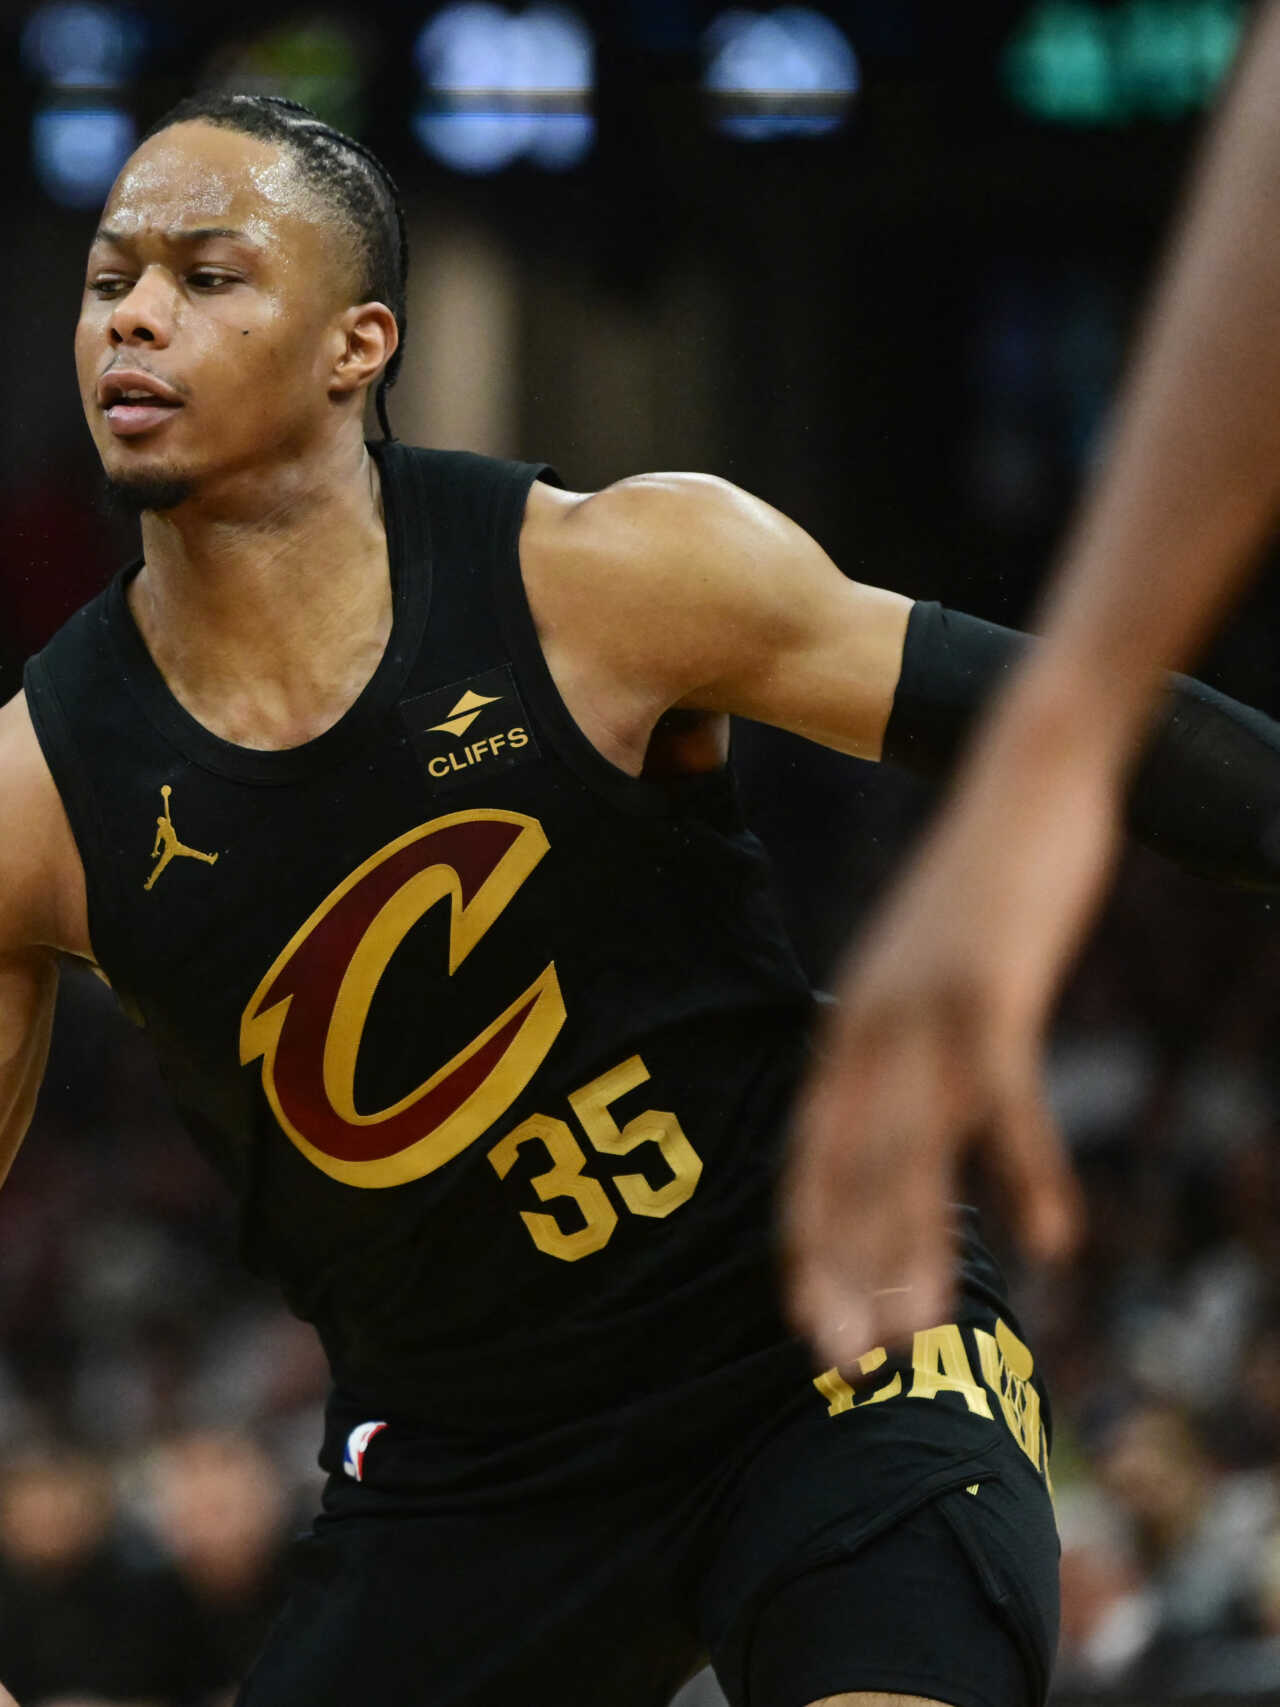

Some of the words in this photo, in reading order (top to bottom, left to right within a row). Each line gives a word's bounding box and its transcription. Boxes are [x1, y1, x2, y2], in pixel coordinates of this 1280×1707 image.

[427, 726, 530, 778] CLIFFS
[239, 808, 568, 1189] C
[486, 1054, 704, 1262] 35
